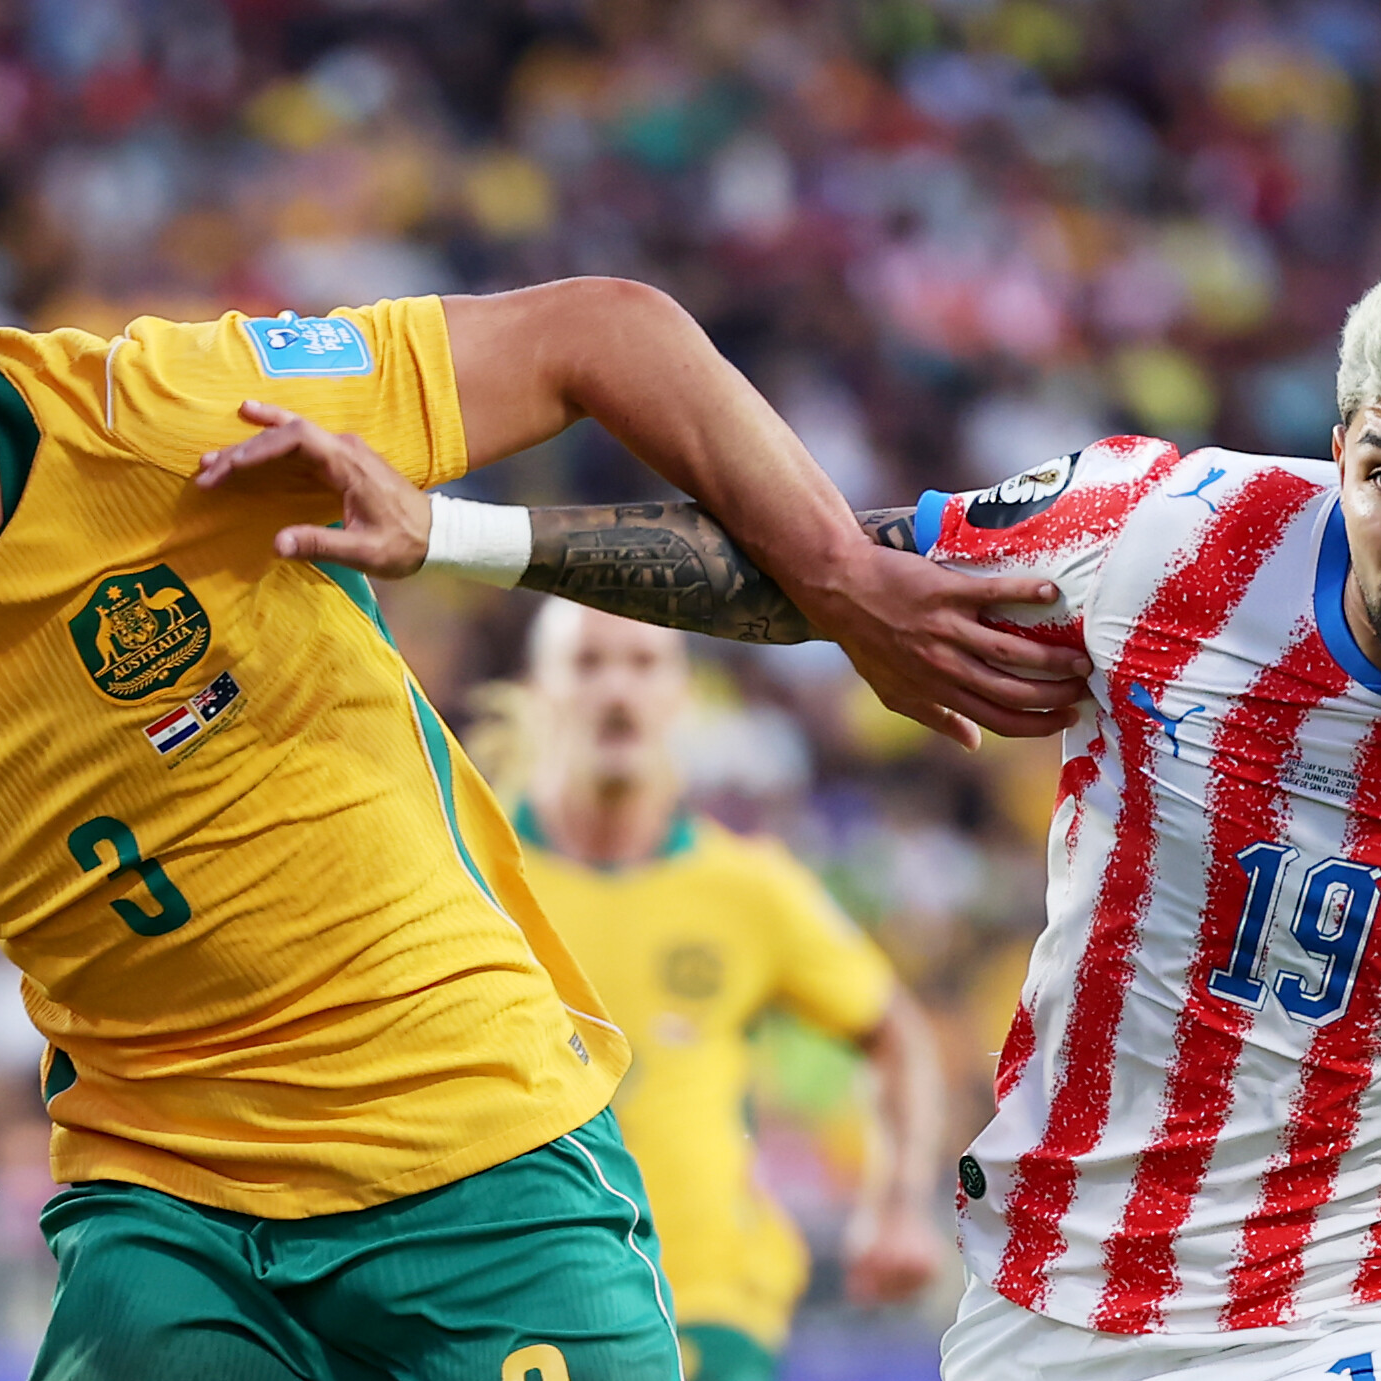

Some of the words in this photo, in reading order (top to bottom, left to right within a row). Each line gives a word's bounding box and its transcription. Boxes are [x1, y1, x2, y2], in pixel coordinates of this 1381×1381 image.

[112, 625, 194, 681] AUSTRALIA
[1286, 758, 1317, 770] ARAGUAY
[1302, 772, 1329, 784] JUNIO
[67, 815, 192, 936] 3
